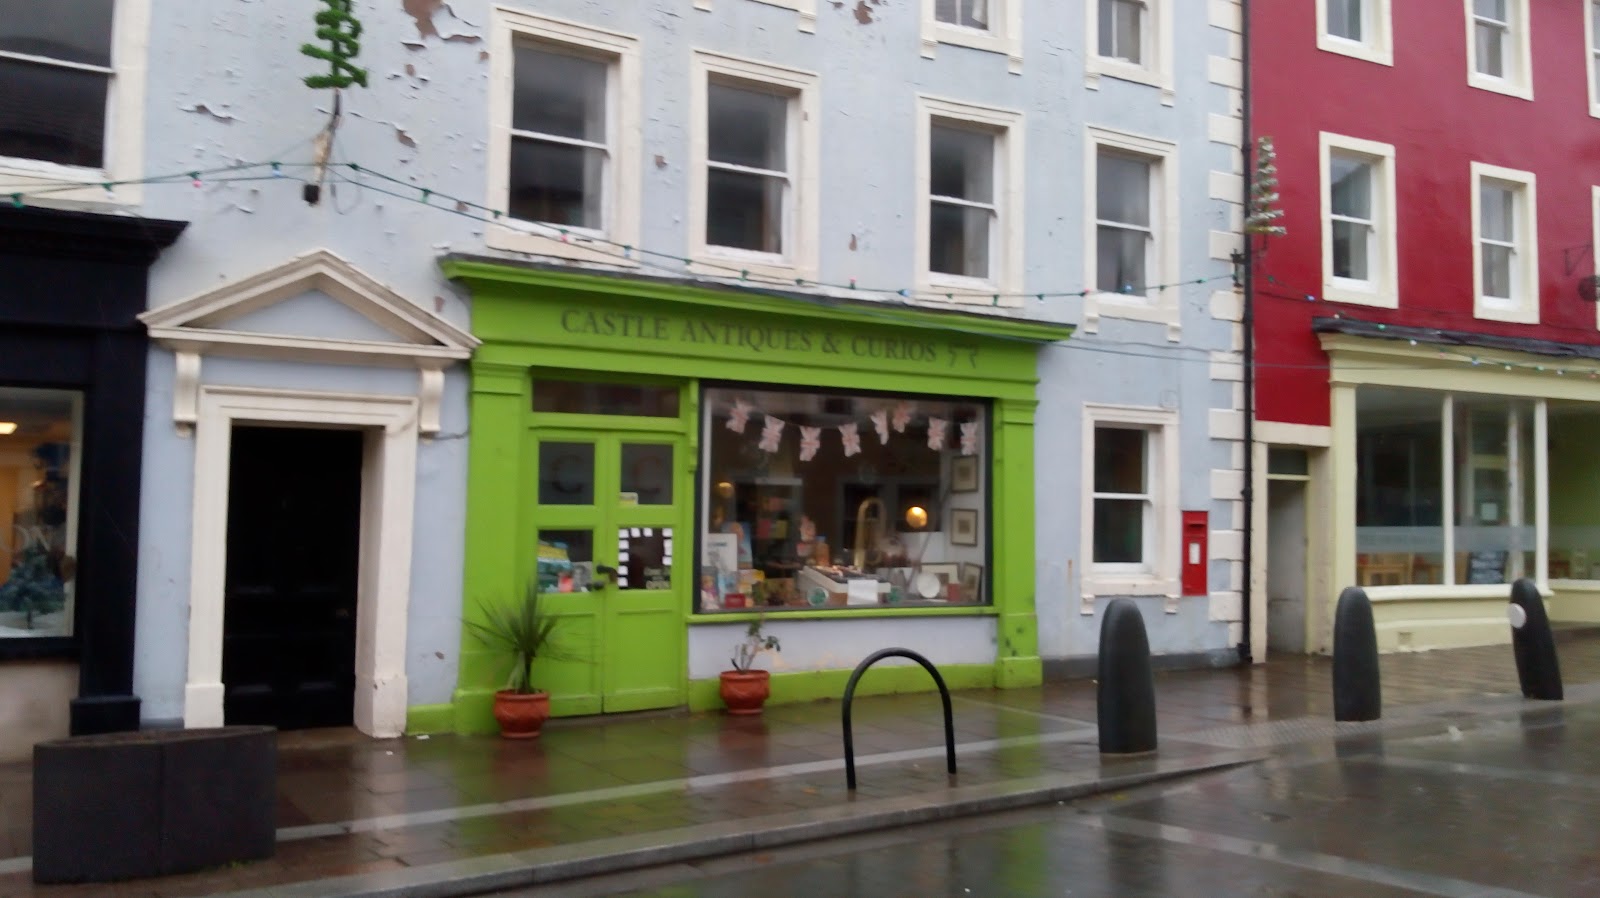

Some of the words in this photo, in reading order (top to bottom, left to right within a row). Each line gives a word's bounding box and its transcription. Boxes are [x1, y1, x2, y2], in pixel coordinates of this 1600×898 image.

[561, 308, 670, 340] CASTLE
[680, 319, 811, 353] ANTIQUES
[821, 331, 840, 354] &
[851, 335, 937, 363] CURIOS
